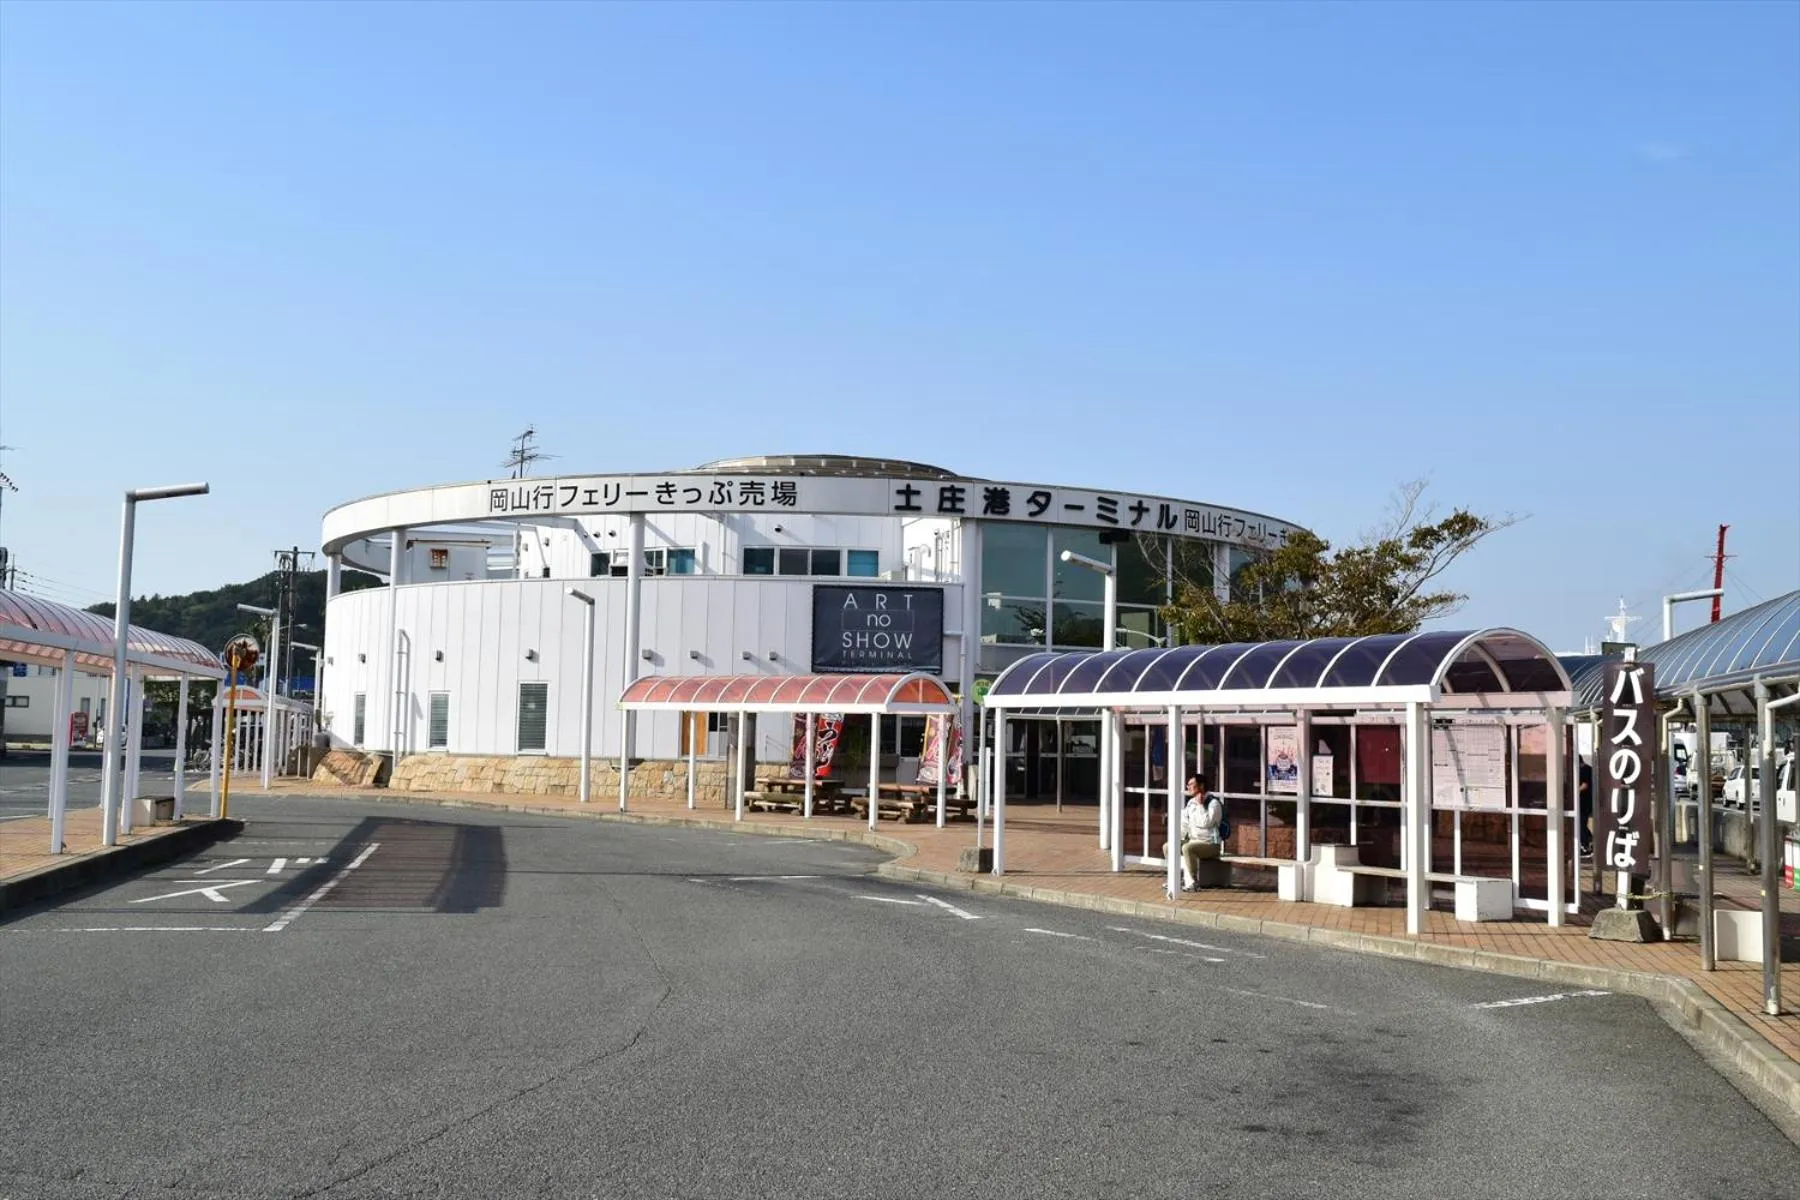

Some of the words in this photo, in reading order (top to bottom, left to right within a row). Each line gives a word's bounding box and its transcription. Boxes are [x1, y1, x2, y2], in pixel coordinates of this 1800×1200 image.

[489, 480, 797, 513] 岡山行フェリーきっぷ売場
[894, 483, 1178, 531] 土庄港ターミナル
[843, 593, 913, 611] ART
[866, 613, 891, 628] no
[842, 631, 913, 649] SHOW
[842, 649, 913, 660] TERMINAL
[1605, 667, 1645, 869] バスのりば
